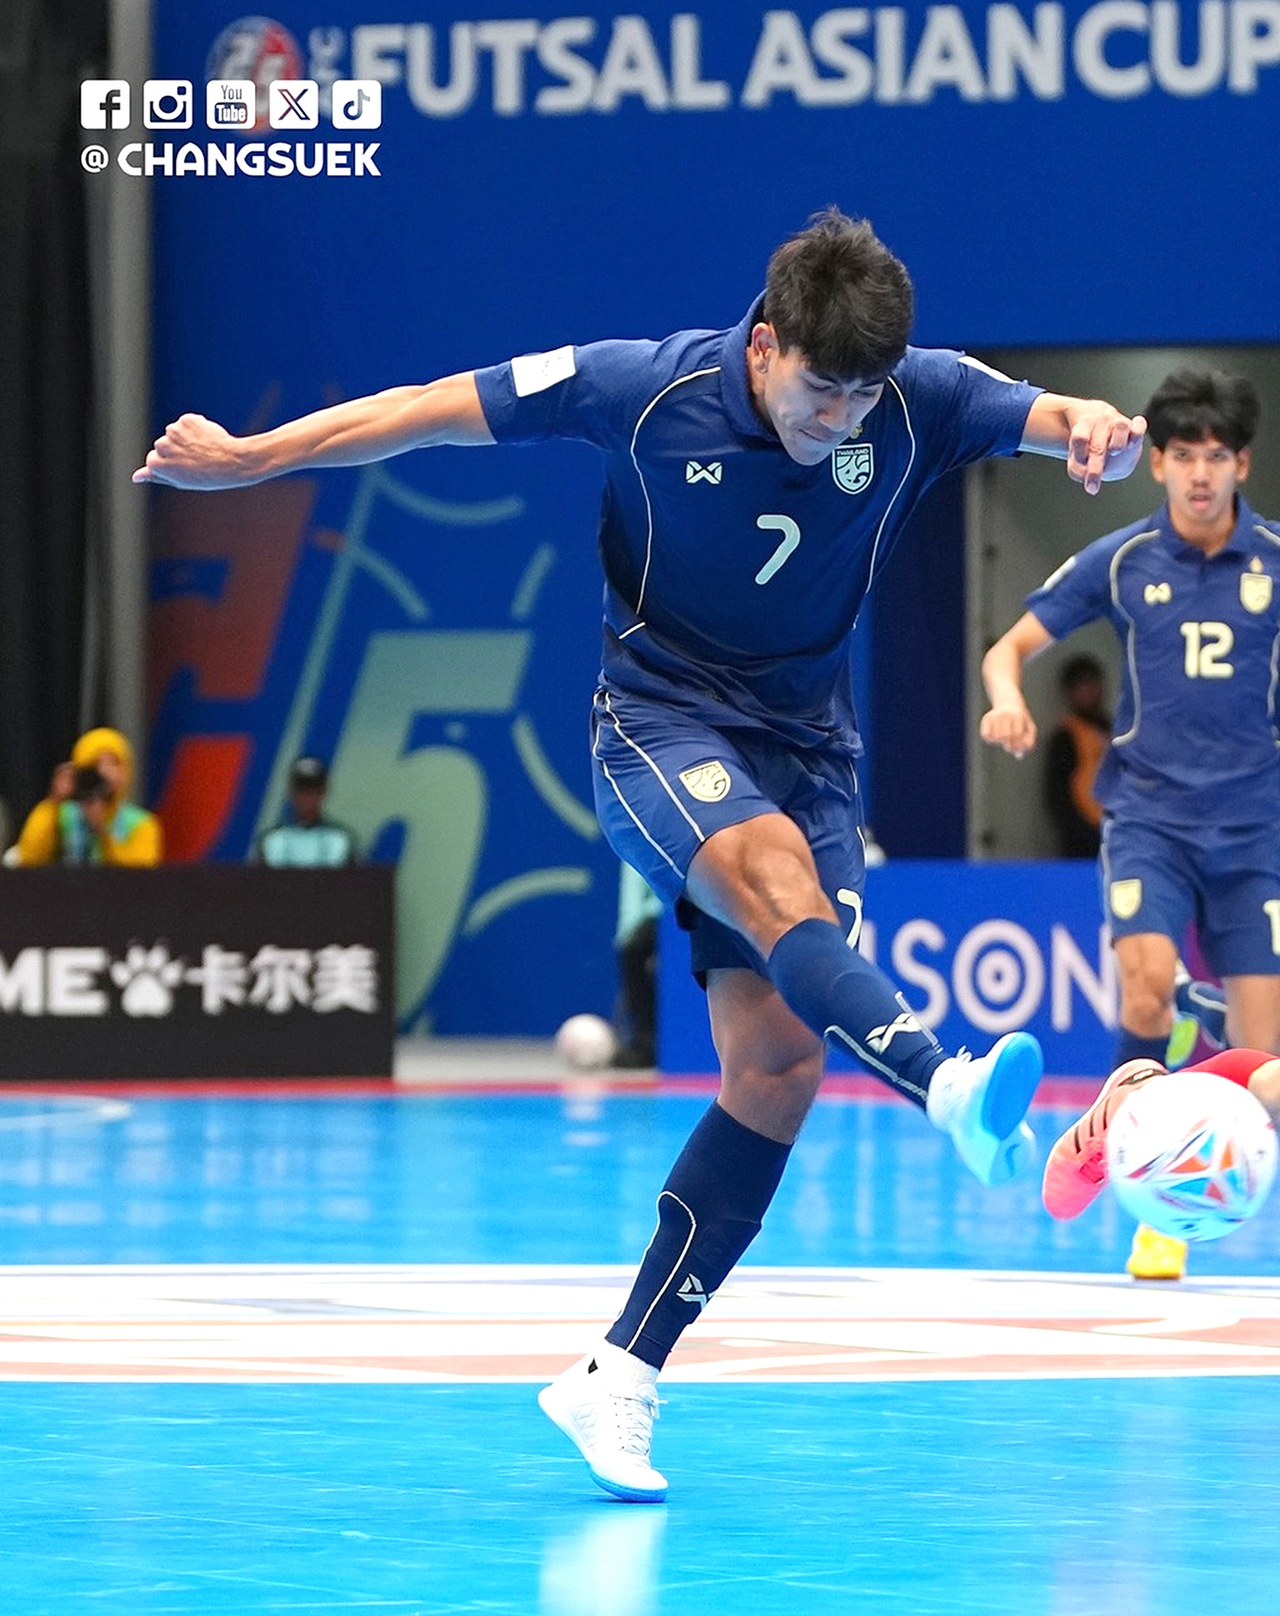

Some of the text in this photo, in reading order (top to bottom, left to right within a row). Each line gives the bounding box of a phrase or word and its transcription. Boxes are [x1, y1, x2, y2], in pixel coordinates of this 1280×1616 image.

[350, 16, 732, 117] FUTSAL
[741, 4, 1065, 107] ASIAN
[755, 514, 801, 586] 7
[1180, 621, 1234, 679] 12
[836, 887, 862, 950] 7
[184, 943, 378, 1015] 卡尔美
